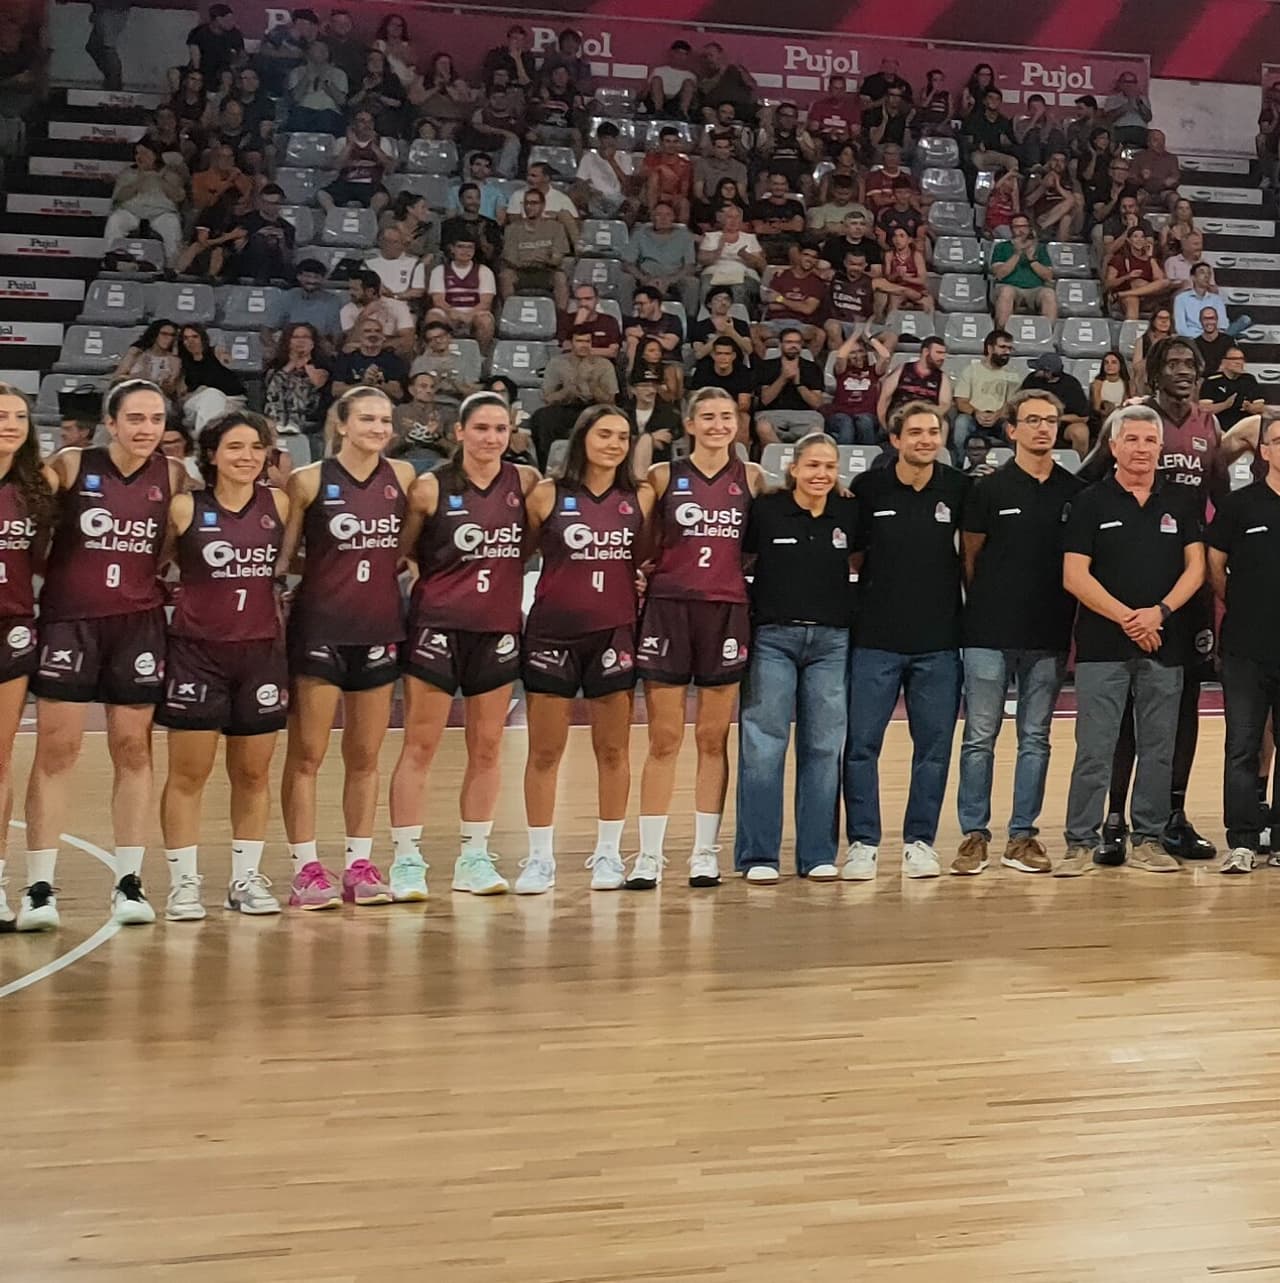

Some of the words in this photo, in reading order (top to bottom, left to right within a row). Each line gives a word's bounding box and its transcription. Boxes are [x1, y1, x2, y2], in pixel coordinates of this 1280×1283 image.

[531, 27, 613, 58] Pol
[784, 45, 861, 77] Pujol
[1021, 62, 1094, 92] Pujol
[31, 238, 58, 248] Pujol
[8, 280, 37, 291] Pujol
[698, 547, 712, 567] 2
[106, 564, 121, 588] 9
[357, 560, 370, 582] 6
[476, 570, 491, 592] 5
[592, 571, 604, 592] 4
[235, 589, 247, 611] 7
